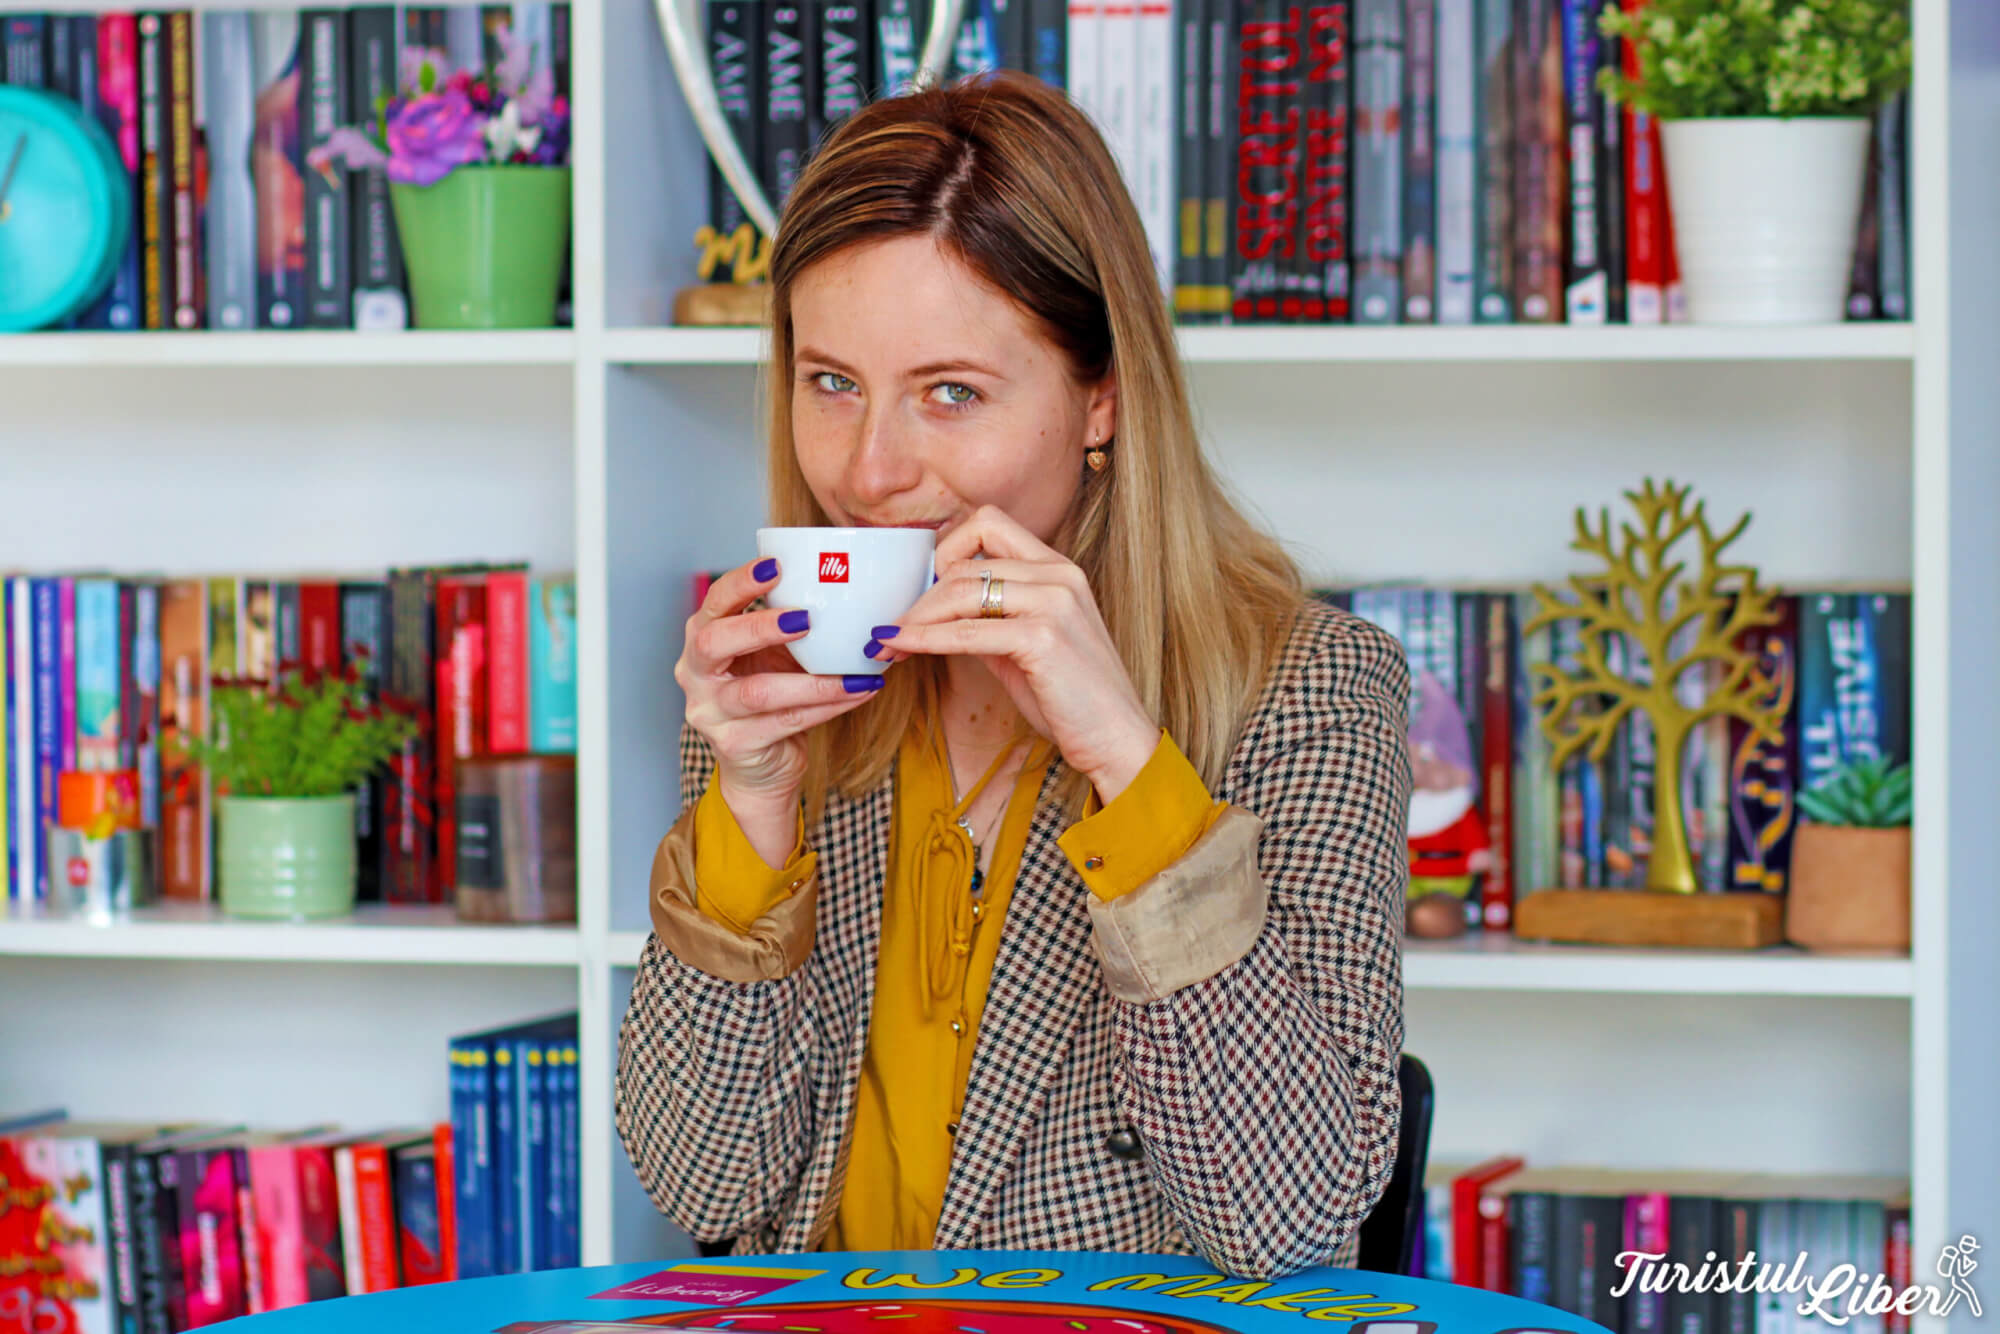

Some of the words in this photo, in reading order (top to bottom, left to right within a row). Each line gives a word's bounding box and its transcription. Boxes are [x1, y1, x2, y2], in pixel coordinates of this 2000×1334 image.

[767, 31, 805, 121] AME
[1307, 4, 1347, 83] NOI
[1237, 6, 1302, 261] SECRETUL
[820, 557, 847, 581] illy
